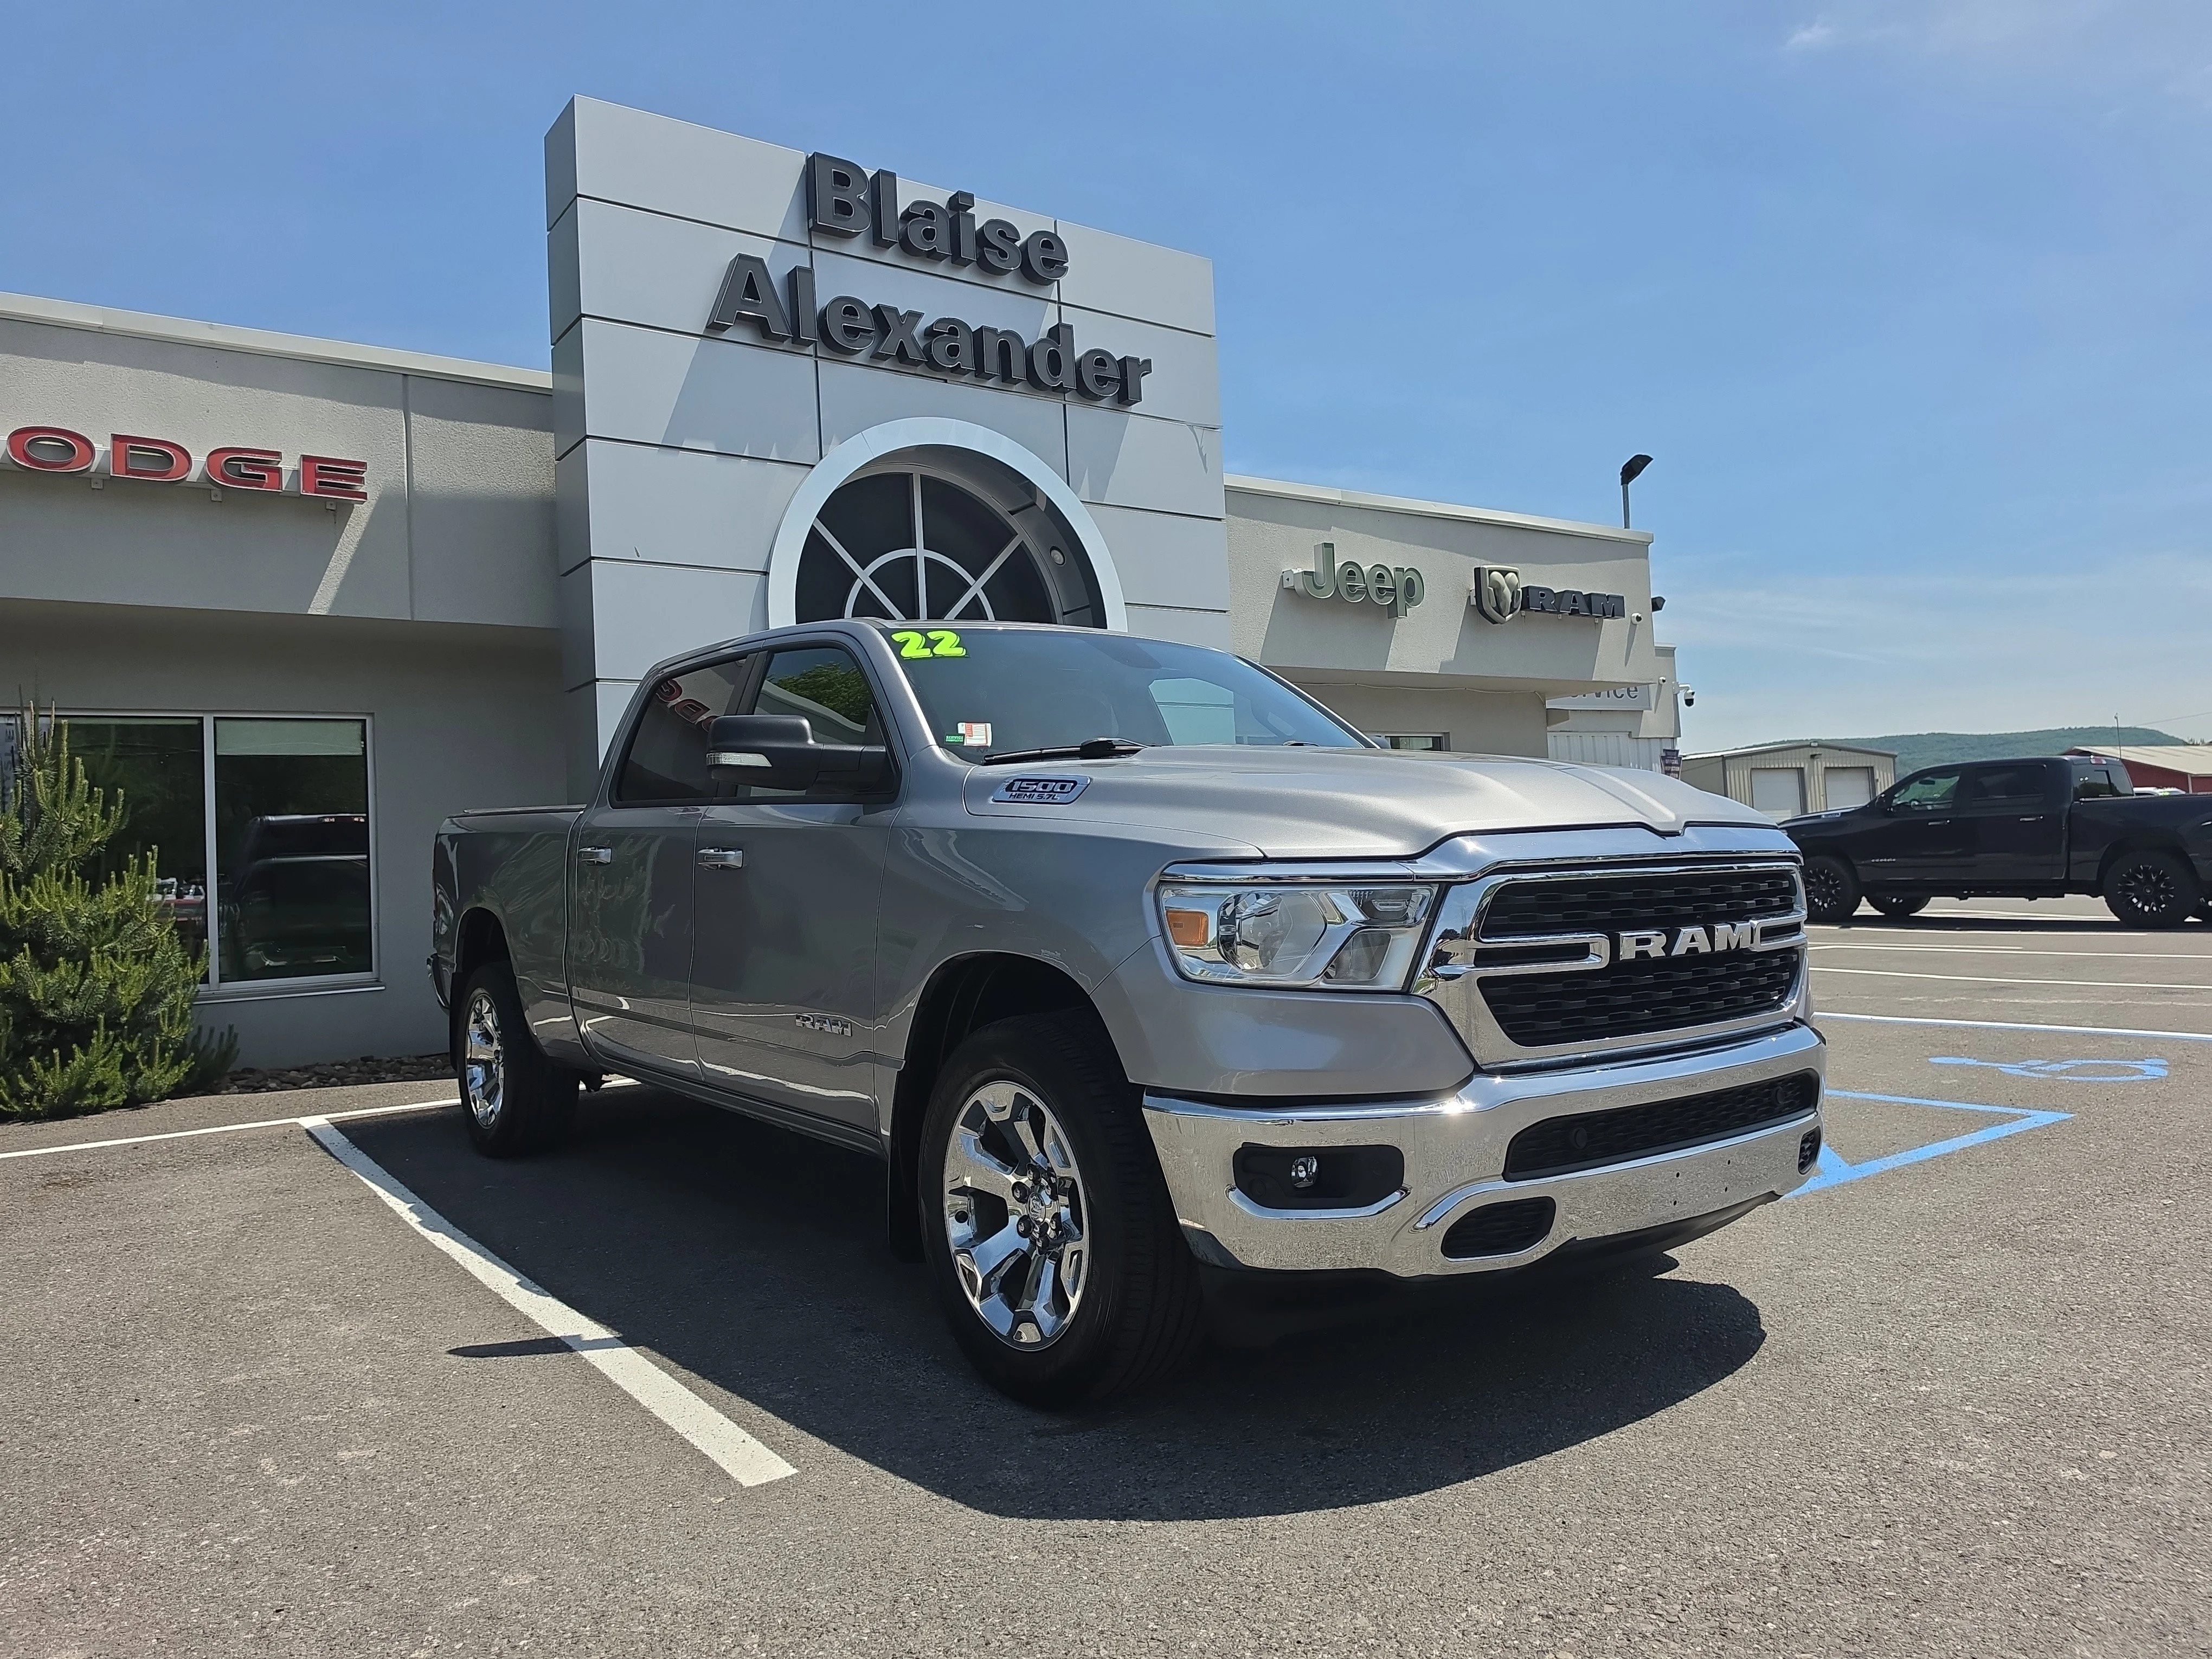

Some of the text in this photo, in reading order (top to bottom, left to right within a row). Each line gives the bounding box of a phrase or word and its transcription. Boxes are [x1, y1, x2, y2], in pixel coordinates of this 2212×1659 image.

[807, 151, 1069, 286] Blaise
[706, 253, 1153, 407] Alexander
[1294, 543, 1424, 619] Jeep
[1521, 585, 1625, 619] RAM
[891, 631, 968, 659] 22
[1011, 781, 1074, 792] 1500
[1619, 922, 1751, 961] RAM
[795, 1013, 853, 1037] RAM
